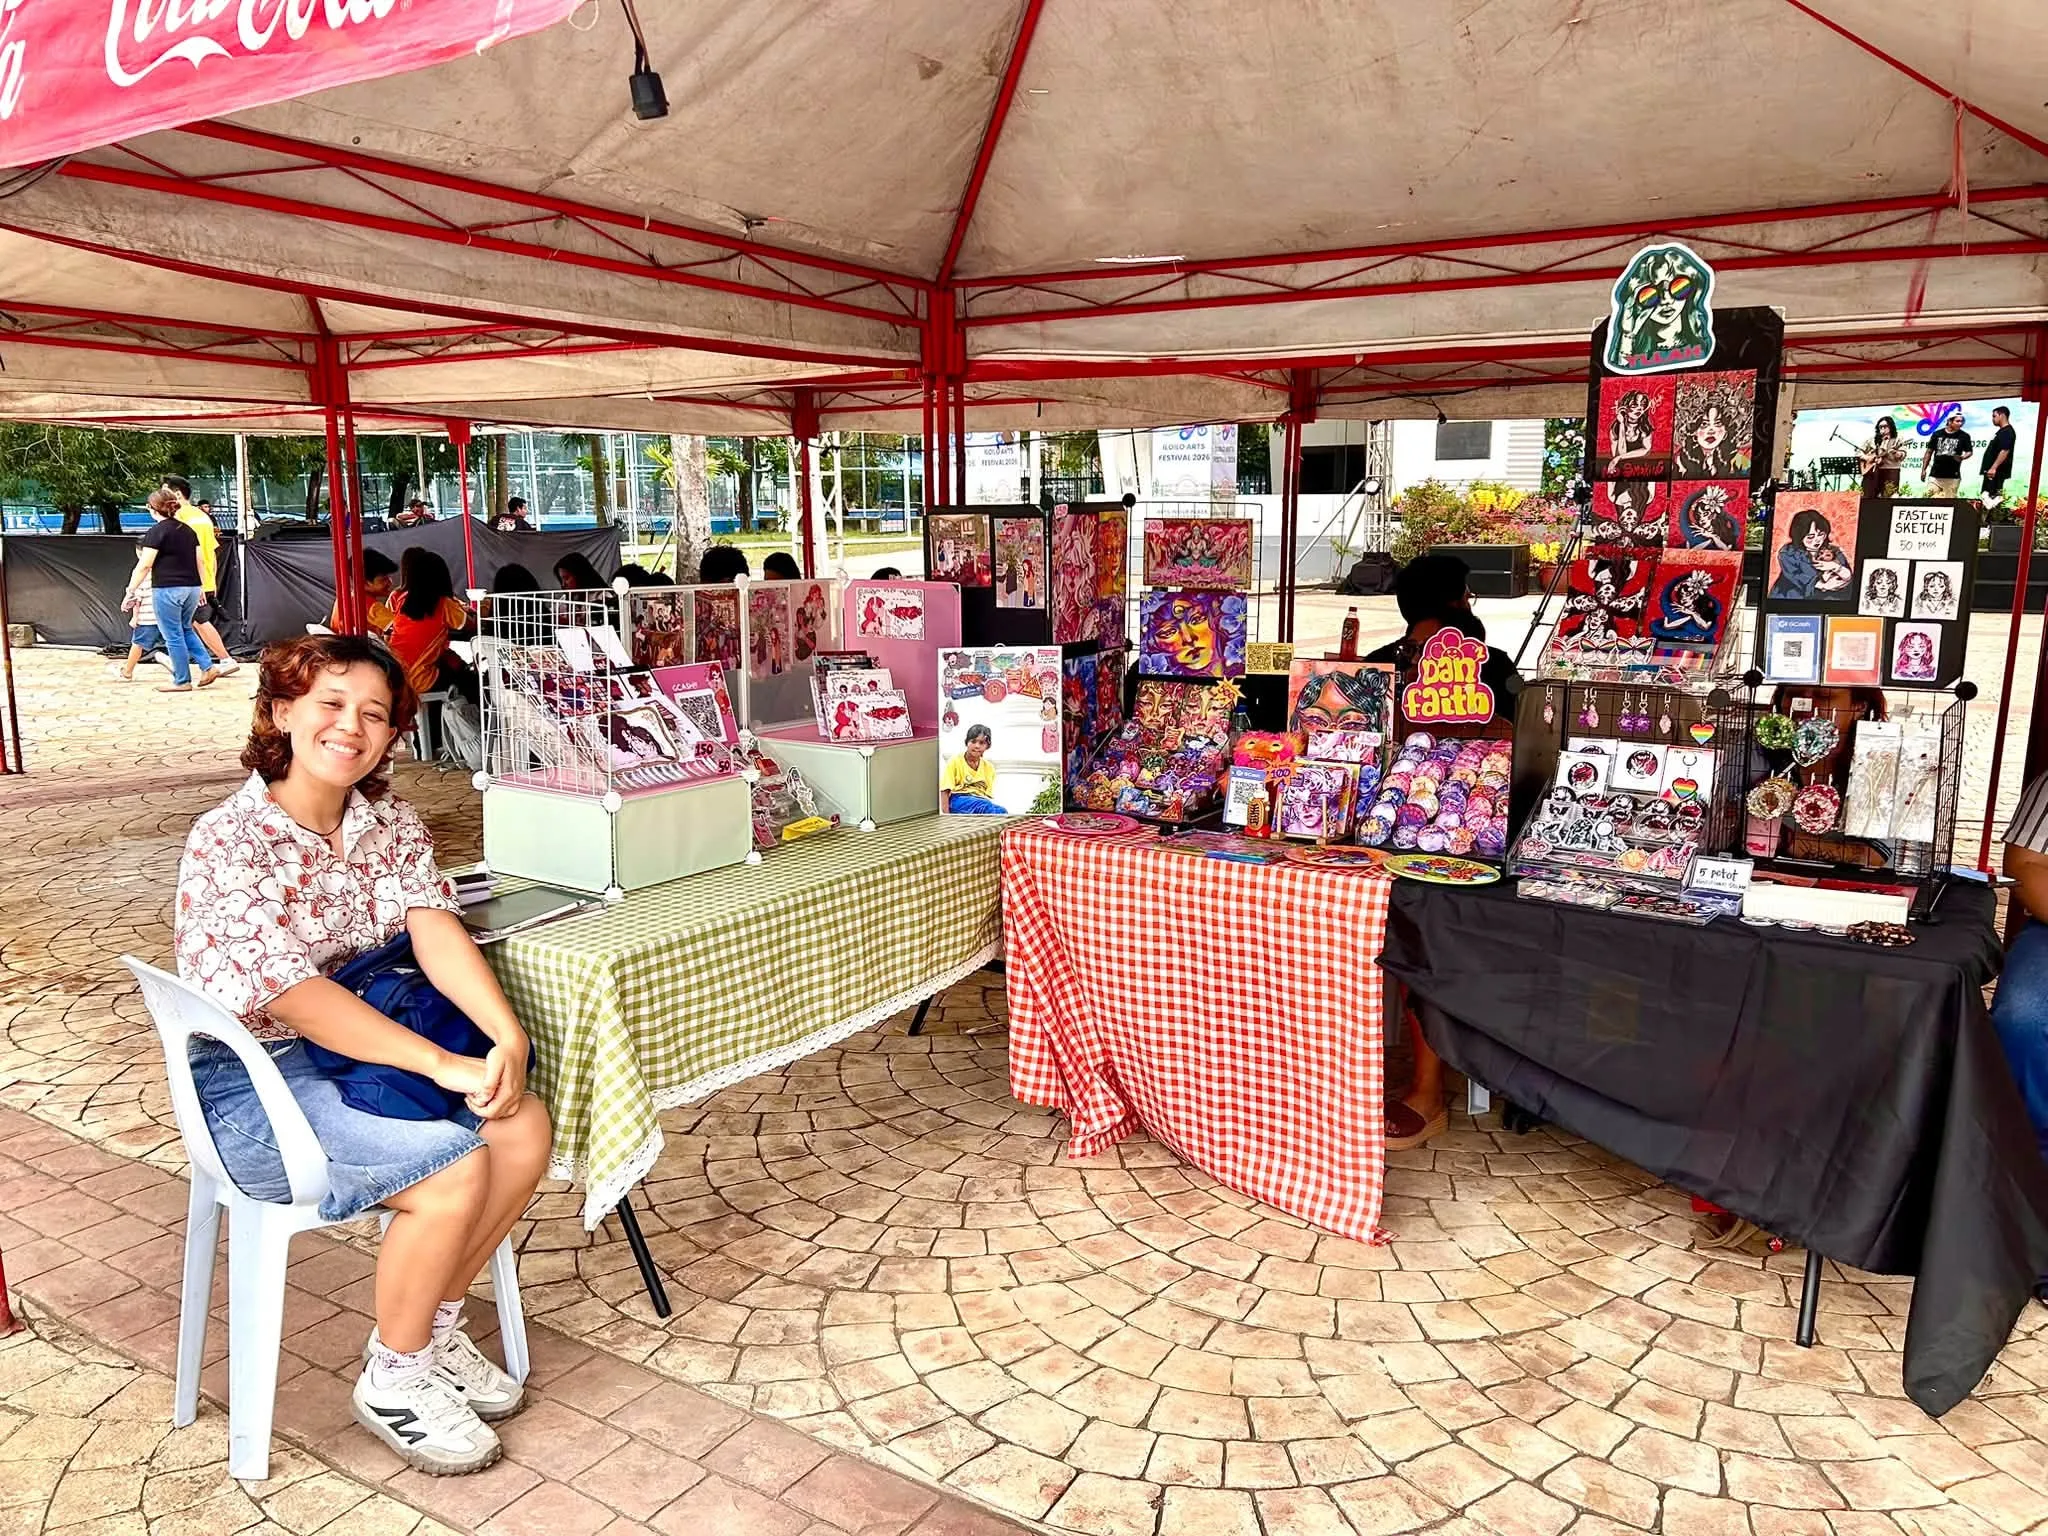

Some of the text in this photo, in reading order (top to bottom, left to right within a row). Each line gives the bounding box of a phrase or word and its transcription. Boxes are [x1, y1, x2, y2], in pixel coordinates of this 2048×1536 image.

[1898, 510, 1950, 521] FAST LIVE
[1895, 522, 1945, 536] SKETCH
[1899, 539, 1913, 551] 50
[1404, 683, 1490, 717] faith
[695, 743, 714, 757] 150
[718, 759, 731, 773] 50
[1270, 768, 1291, 778] 100
[1699, 867, 1708, 877] 5
